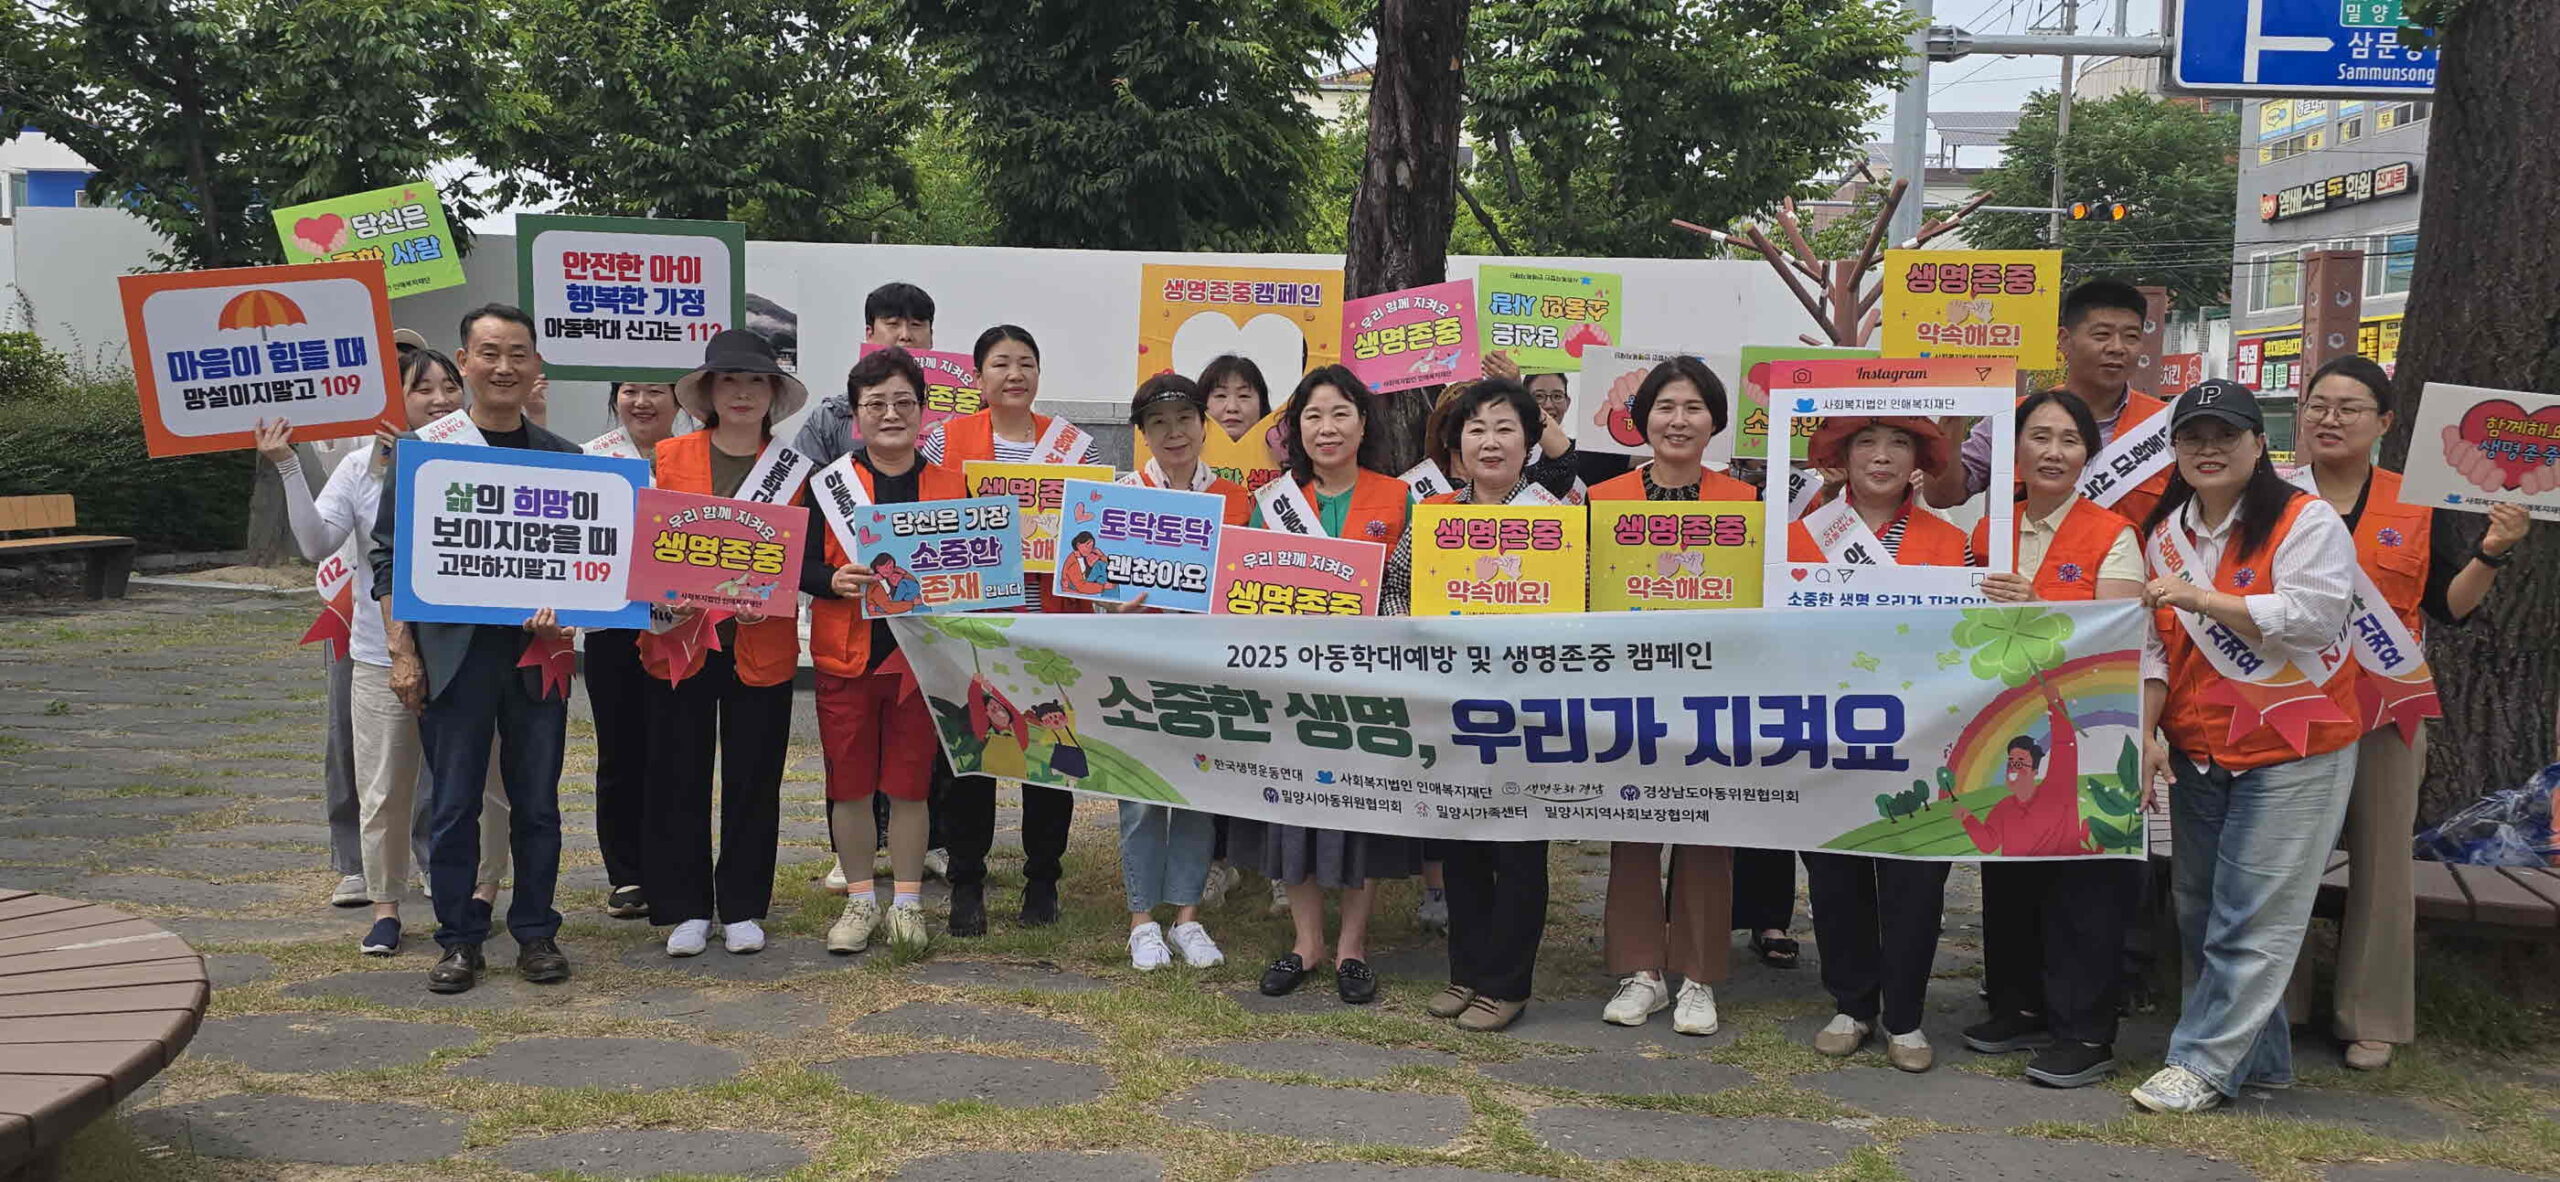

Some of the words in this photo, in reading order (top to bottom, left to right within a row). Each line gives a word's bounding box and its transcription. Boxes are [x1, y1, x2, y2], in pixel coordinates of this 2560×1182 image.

[2337, 63, 2435, 85] Sammunsong
[351, 204, 428, 239] 당신은
[391, 235, 441, 266] 사람
[563, 251, 644, 282] 안전한
[650, 255, 702, 284] 아이
[1906, 263, 2036, 295] 생명존중
[566, 283, 648, 315] 행복한
[653, 288, 705, 317] 가정
[1163, 279, 1322, 306] 생명존중캠페인
[1489, 292, 1537, 316] 사람
[1361, 307, 1385, 329] 우리
[1385, 297, 1409, 313] 함께
[1413, 297, 1449, 317] 지켜요
[1540, 295, 1609, 322] 소중한
[544, 318, 621, 339] 아동학대
[625, 320, 682, 341] 신고는
[1353, 315, 1462, 360] 생명존중
[1492, 323, 1559, 348] 당신은
[1917, 323, 2020, 346] 약속해요!
[166, 345, 260, 383] 마음이
[266, 339, 330, 374] 힘들
[333, 336, 368, 367] 때
[940, 360, 974, 387] 지켜요
[1857, 367, 1927, 383] Instagram
[183, 378, 317, 411] 망설이지말고
[321, 375, 361, 398] 109
[928, 384, 982, 415] 존중
[1823, 398, 1887, 411] 사회복지법인
[1890, 398, 1956, 410] 인애복지재단
[2197, 385, 2222, 406] P
[2478, 439, 2560, 466] 생명존중
[445, 482, 505, 514] 삶의
[513, 486, 599, 520] 희망이
[668, 508, 699, 529] 우리
[702, 505, 732, 521] 함께
[735, 509, 777, 541] 지켜요
[892, 506, 959, 536] 당신은
[965, 505, 1010, 530] 가장
[1099, 507, 1213, 550] 토닥토닥
[1435, 518, 1562, 551] 생명존중
[1614, 514, 1746, 547] 생명존중
[432, 516, 581, 555] 보이지않을
[588, 526, 618, 557] 때
[653, 530, 786, 574] 생명존중
[910, 536, 1003, 571] 소중한
[1243, 552, 1273, 569] 우리
[1277, 550, 1307, 567] 함께
[1309, 554, 1355, 581] 지켜요
[319, 557, 348, 587] 112
[437, 553, 566, 581] 고민하지말고
[573, 561, 611, 582] 109
[1106, 554, 1207, 592] 괜찮아요
[921, 572, 980, 602] 존재
[985, 584, 1022, 598] 입니다
[1447, 580, 1549, 605] 약속해요!
[1627, 576, 1733, 601] 약속해요!
[1788, 592, 1834, 607] 소중한
[1227, 644, 1288, 669] 2025
[1298, 645, 1457, 674] 아동학대예방
[1467, 645, 1491, 674] 및
[1502, 643, 1615, 674] 생명존중
[1627, 641, 1713, 672] 캠페인
[1099, 676, 1273, 743] 소중한
[1284, 691, 1438, 769] 생명,
[1451, 697, 1668, 765] 우리가
[1682, 694, 1910, 772] 지켜요
[1213, 757, 1304, 782] 한국생명운동연대
[1339, 771, 1412, 793] 사회복지법인
[1416, 780, 1493, 799] 인애복지재단
[1643, 785, 1800, 804] 경상남도아동위원협의회
[1281, 788, 1403, 814] 밀양시아동위원협의회
[1436, 803, 1529, 820] 밀양시가족센터
[1544, 804, 1709, 823] 밀양시지역사회보장협의체
